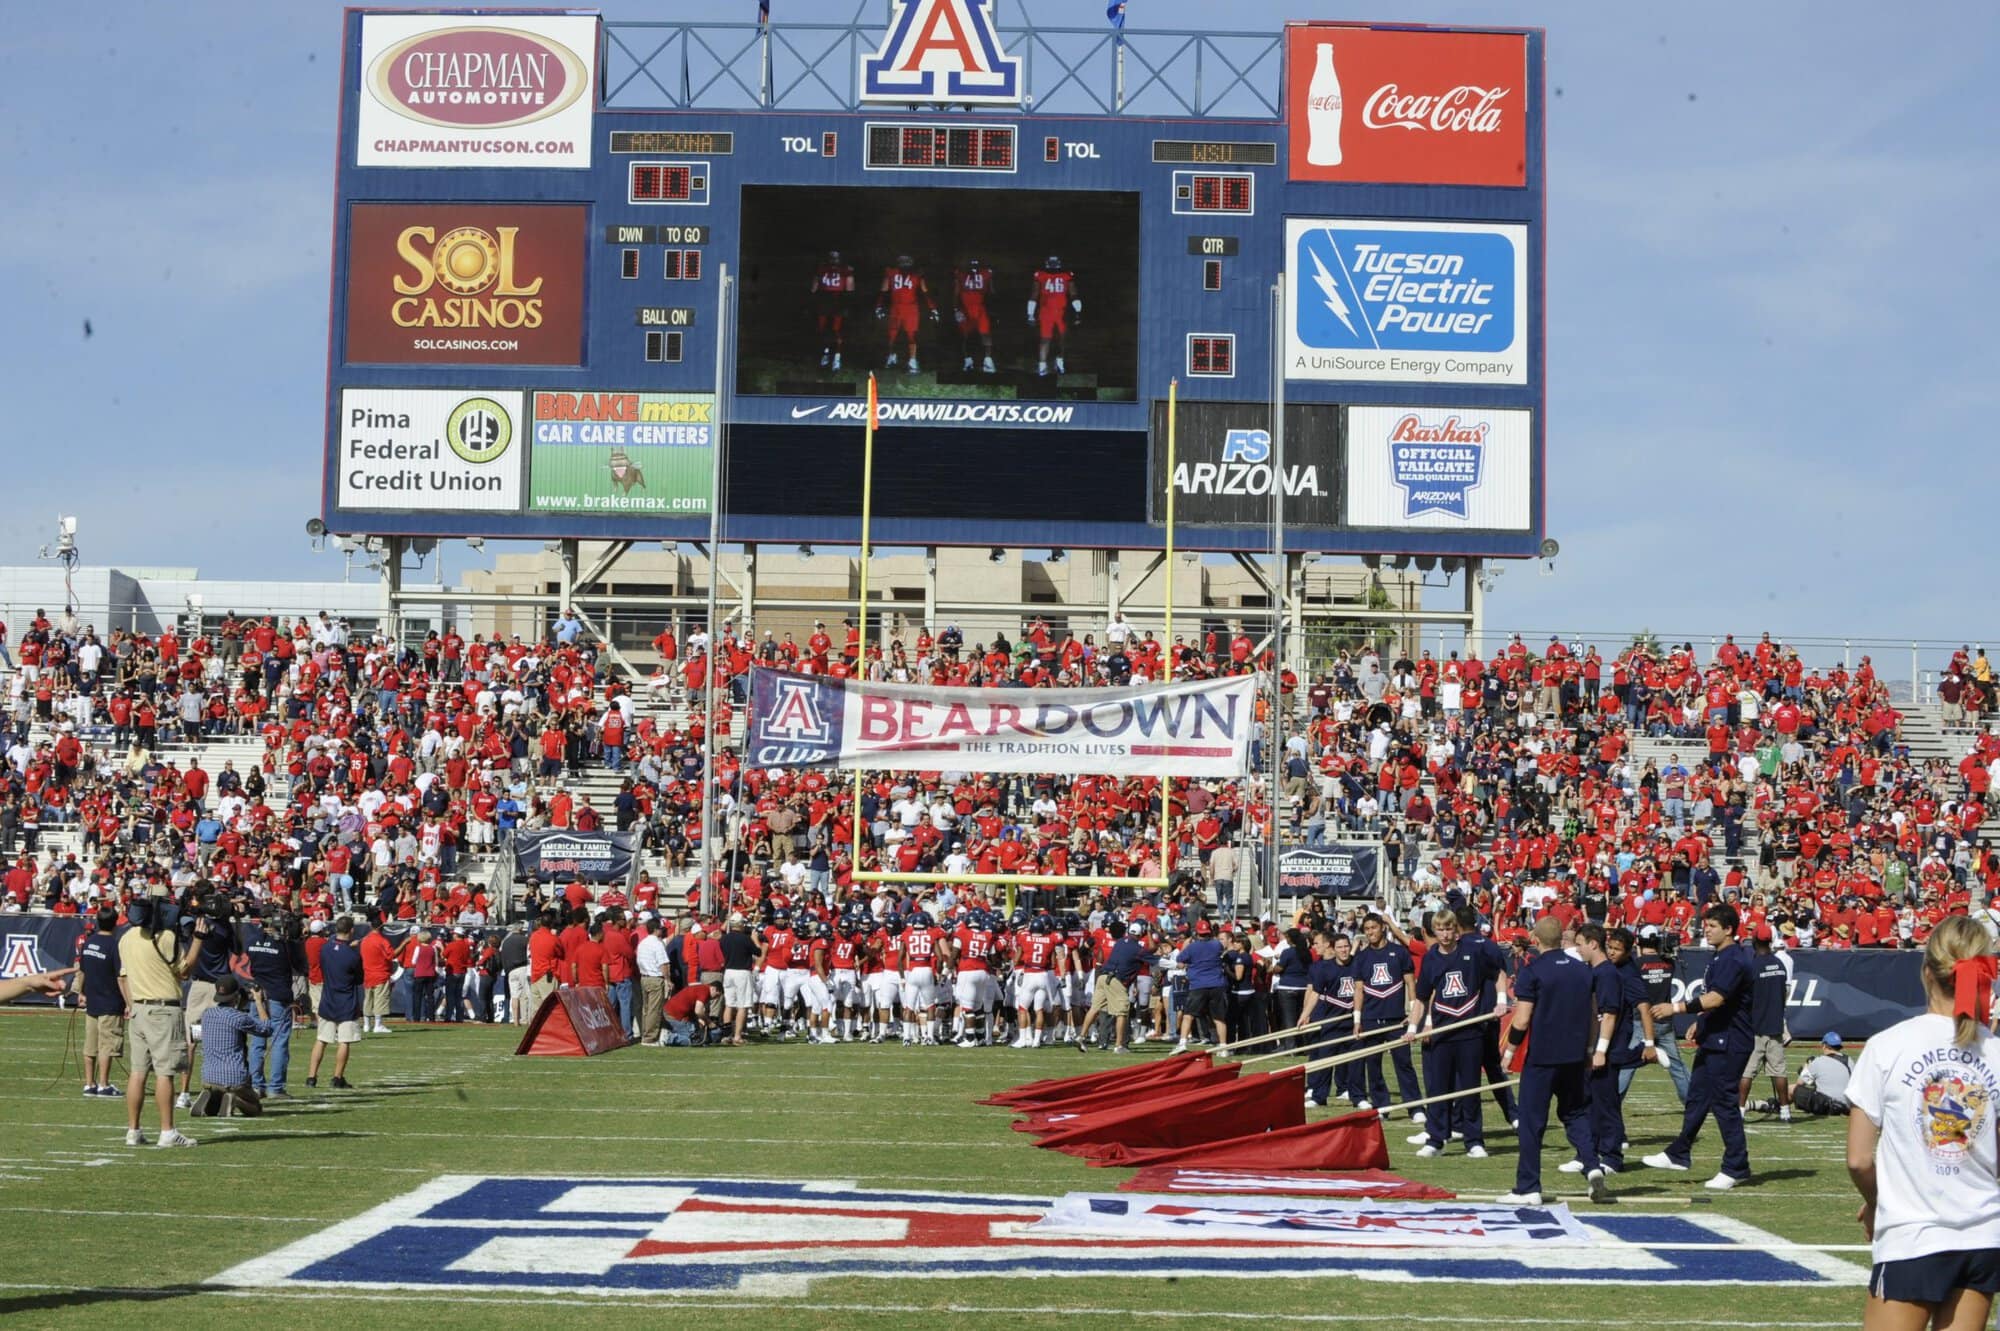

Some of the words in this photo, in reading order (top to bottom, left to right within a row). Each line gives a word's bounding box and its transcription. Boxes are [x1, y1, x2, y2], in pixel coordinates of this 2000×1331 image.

[404, 52, 549, 89] CHAPMAN
[408, 90, 545, 105] AUTOMOTIVE
[1362, 83, 1511, 132] Coca-Cola
[374, 139, 575, 154] CHAPMANTUCSON.COM
[631, 134, 713, 152] ARIZONA
[781, 137, 817, 153] TOL
[903, 128, 1012, 165] 5:15
[1064, 142, 1101, 158] TOL
[1192, 144, 1232, 162] WSU
[1193, 177, 1249, 209] 00
[618, 227, 643, 242] DWN
[667, 227, 681, 242] TO
[684, 228, 701, 243] GO
[1202, 238, 1224, 253] QTR
[393, 226, 543, 296] SOL
[1352, 244, 1464, 274] Tucson
[821, 272, 840, 287] 42
[894, 274, 913, 290] 94
[1045, 277, 1065, 292] 46
[1363, 275, 1494, 304] Electric
[391, 297, 543, 328] CASINOS
[642, 309, 668, 325] BALL
[671, 309, 688, 325] ON
[1376, 304, 1493, 334] Power
[413, 339, 518, 351] SOLCASINOS.COM
[1295, 356, 1306, 369] A
[1311, 356, 1385, 371] UniSource
[1390, 358, 1441, 376] Energy
[1445, 359, 1513, 376] Company
[535, 393, 640, 422] BRAKE
[640, 400, 713, 423] max
[351, 409, 411, 429] Pima
[537, 425, 573, 443] CAR
[580, 426, 625, 444] CARE
[631, 426, 709, 445] CENTERS
[350, 438, 440, 460] Federal
[1222, 429, 1271, 463] FS
[1398, 448, 1475, 460] OFFICIAL
[1398, 461, 1475, 472] TAILGATE
[348, 470, 424, 491] Credit
[430, 471, 502, 491] Union
[1166, 462, 1319, 496] ARIZONA
[1398, 473, 1474, 481] HEADQUARTERS
[535, 493, 707, 510] www.brakemax.com
[1411, 491, 1461, 501] ARIZONA
[760, 677, 829, 744] A
[758, 746, 827, 764] CLUB
[965, 742, 991, 753] THE
[999, 742, 1080, 755] TRADITION
[1085, 744, 1126, 755] LIVES
[583, 843, 611, 851] FAMILY
[837, 943, 853, 959] 47
[909, 935, 931, 955] 26
[1032, 943, 1043, 963] 2
[1370, 963, 1393, 986] A
[1442, 970, 1468, 999] A
[1903, 1048, 2000, 1101] HOMECOMING
